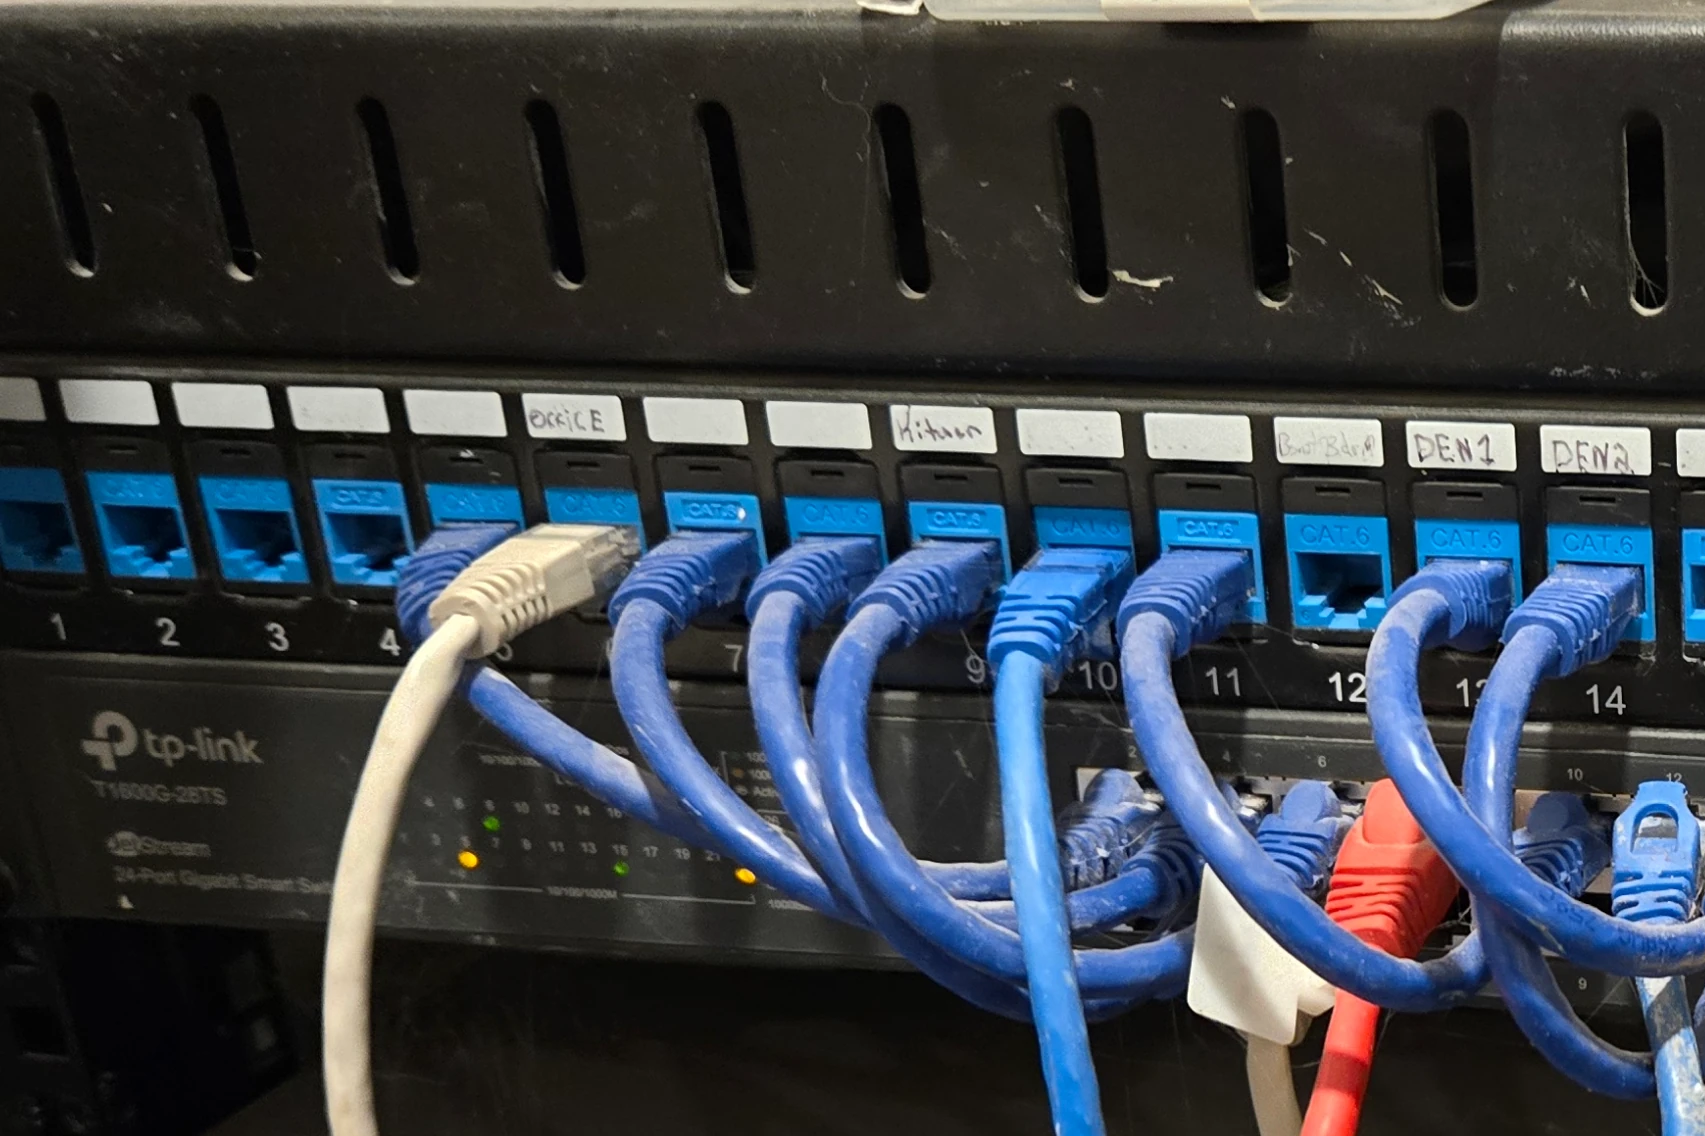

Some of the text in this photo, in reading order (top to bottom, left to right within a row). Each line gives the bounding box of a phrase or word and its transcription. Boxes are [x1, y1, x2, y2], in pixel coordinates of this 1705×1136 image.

[1300, 523, 1371, 547] CAT.6
[1431, 527, 1502, 550] CAT.6
[1562, 532, 1634, 557] CAT.6
[51, 613, 67, 640] 1
[156, 617, 181, 646] 2
[265, 622, 290, 651] 3
[379, 628, 402, 656] 4
[724, 644, 743, 673] 7
[966, 654, 987, 684] 9
[1078, 662, 1119, 691] 10
[1205, 667, 1241, 697] 11
[1586, 685, 1627, 715] 14
[142, 726, 265, 768] tp-link
[1128, 745, 1137, 758] 2
[1317, 755, 1328, 768] 6
[1566, 768, 1584, 781] 10
[1577, 978, 1588, 991] 9
